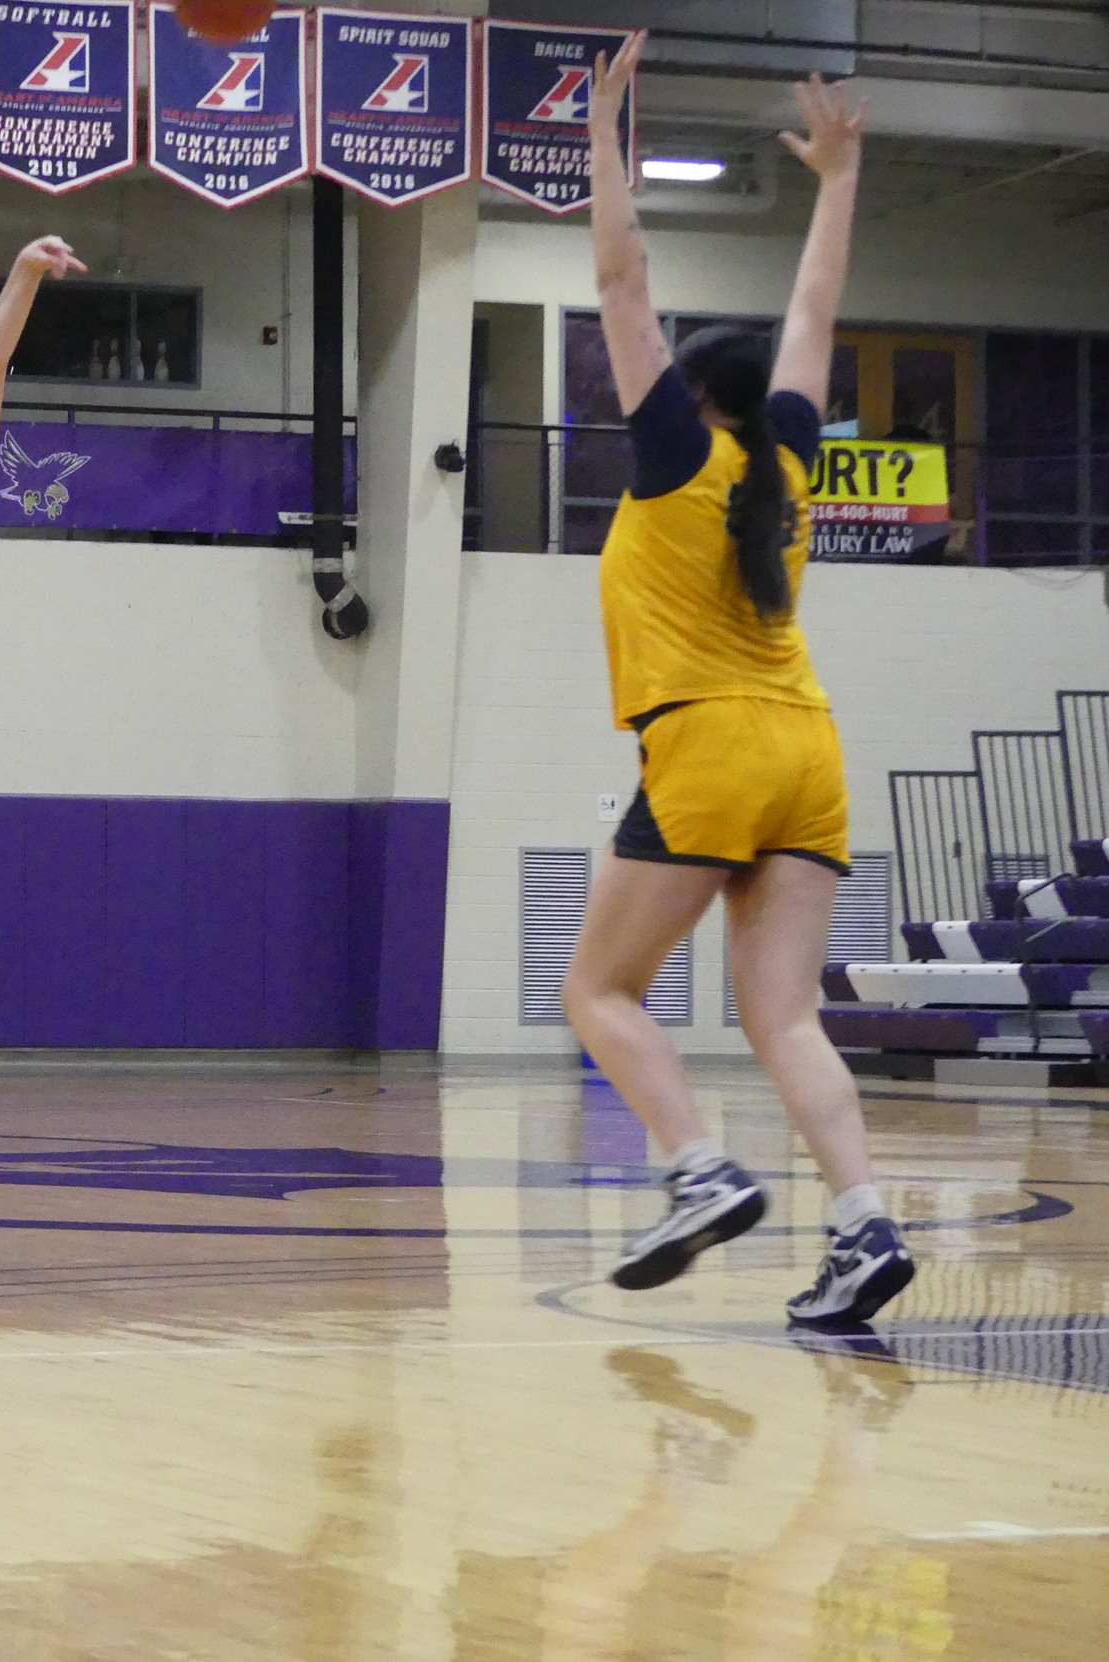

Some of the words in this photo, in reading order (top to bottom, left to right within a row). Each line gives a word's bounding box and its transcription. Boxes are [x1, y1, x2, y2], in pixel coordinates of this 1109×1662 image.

[338, 25, 395, 45] SPIRIT
[398, 30, 450, 48] SQUAD
[534, 41, 585, 59] DANCE
[1, 141, 97, 160] CHAMPION
[164, 131, 290, 151] CONFERENCE
[331, 133, 455, 154] CONFERENCE
[177, 148, 278, 167] CHAMPION
[343, 148, 443, 167] CHAMPION
[497, 143, 591, 163] CONFEREN
[510, 157, 590, 177] CHAMPIO
[534, 182, 581, 200] 2017
[809, 448, 916, 497] URT?
[870, 535, 914, 554] LAW
